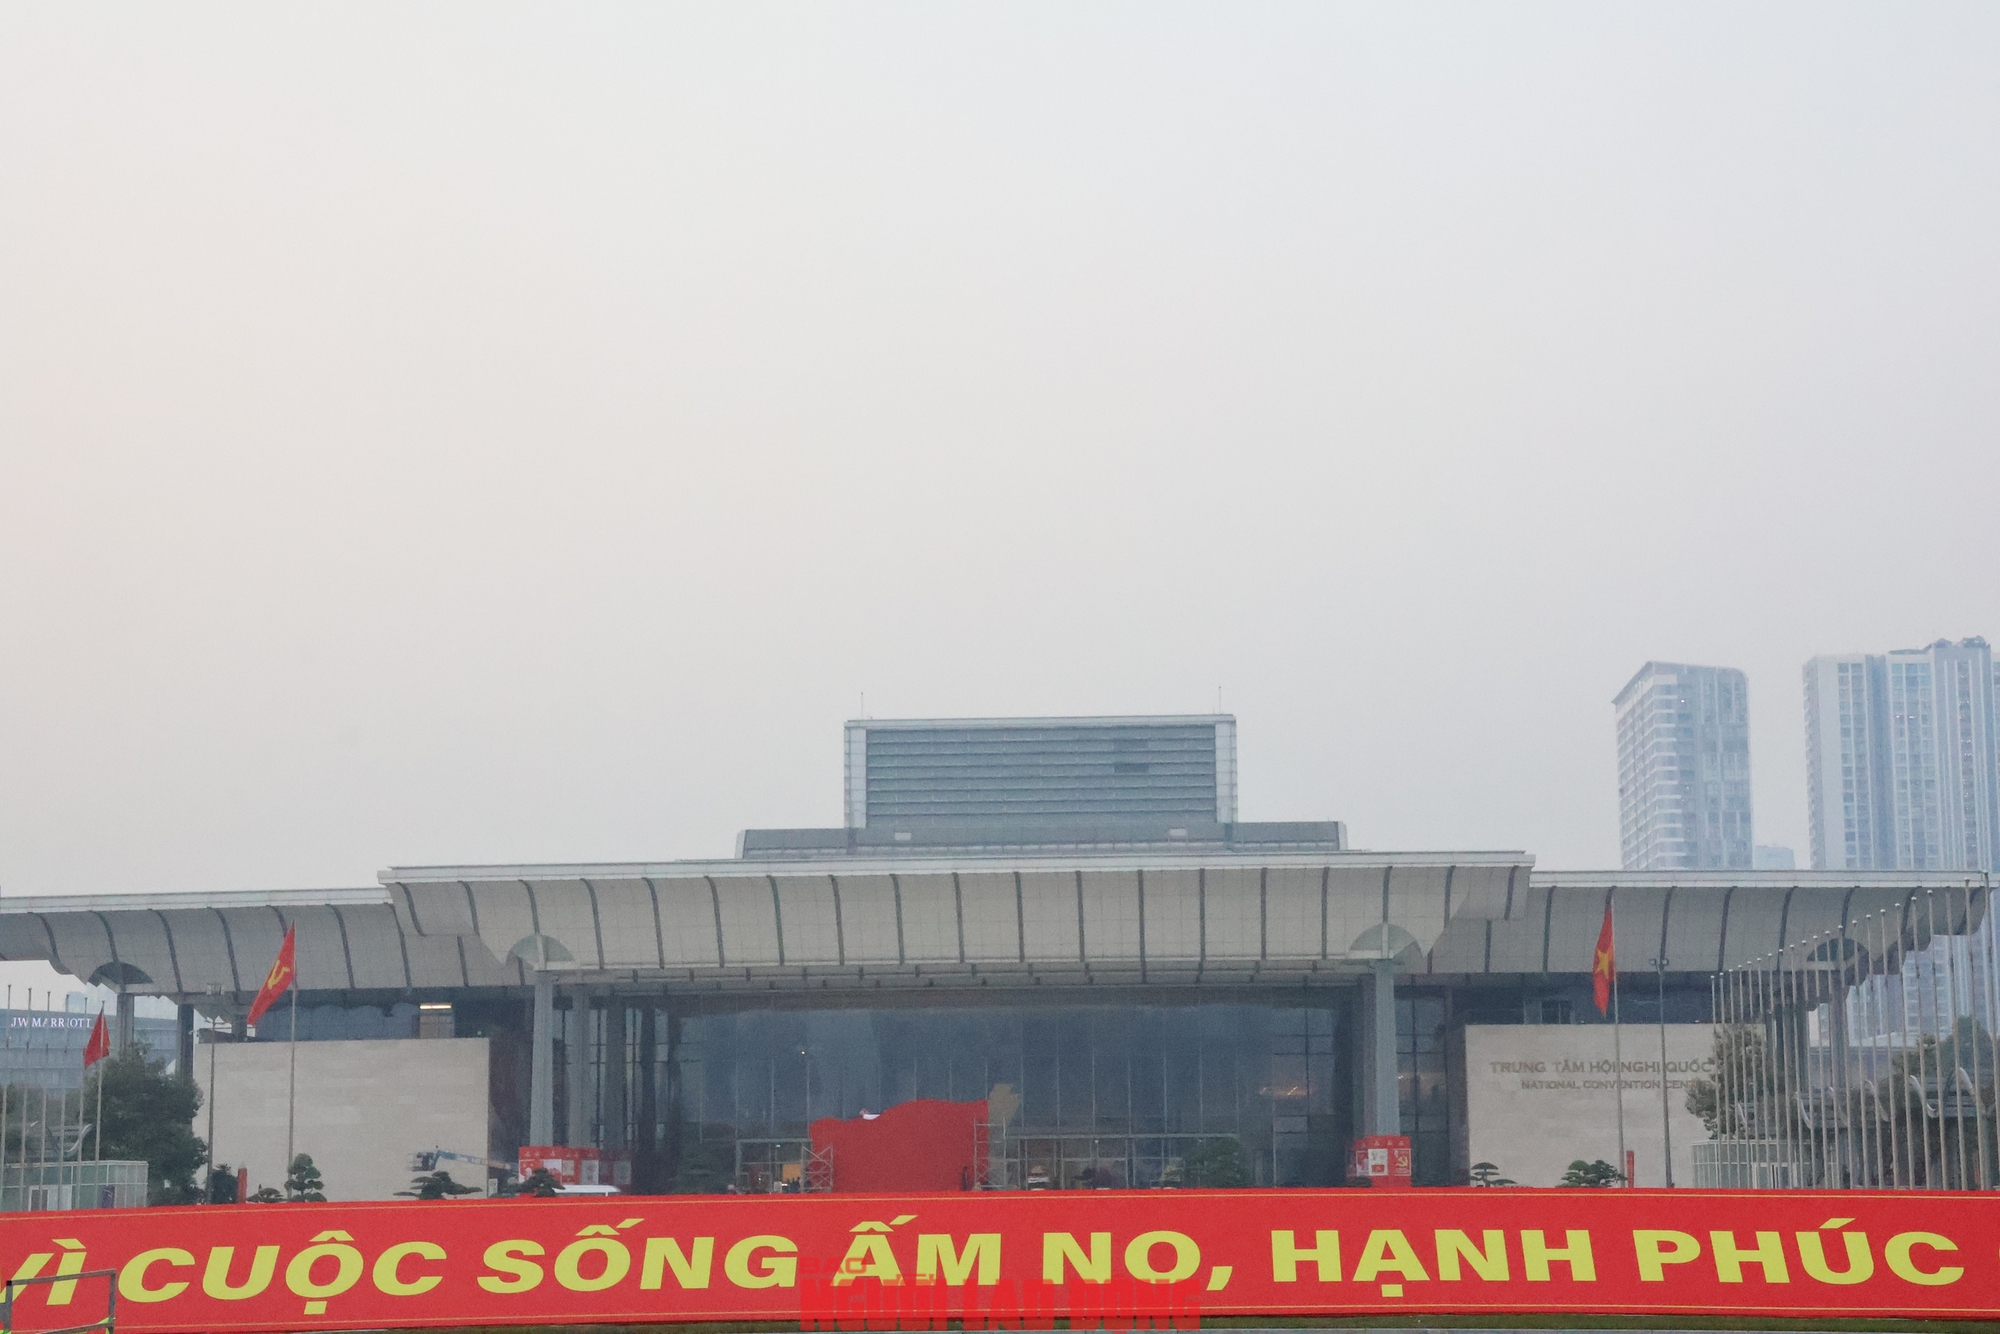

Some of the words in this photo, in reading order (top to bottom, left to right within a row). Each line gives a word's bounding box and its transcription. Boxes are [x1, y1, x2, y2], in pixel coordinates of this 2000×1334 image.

[1490, 1061, 1546, 1074] TRUNG
[1552, 1059, 1585, 1074] TÂM
[1589, 1059, 1617, 1075] HỘI
[1521, 1080, 1580, 1090] NATIONAL
[118, 1229, 447, 1315] CUỘC
[478, 1218, 799, 1294] SỐNG
[829, 1214, 1002, 1287] ẤM
[1043, 1231, 1233, 1291] NO,
[1271, 1229, 1597, 1298] HẠNH
[1633, 1217, 1965, 1286] PHÚC
